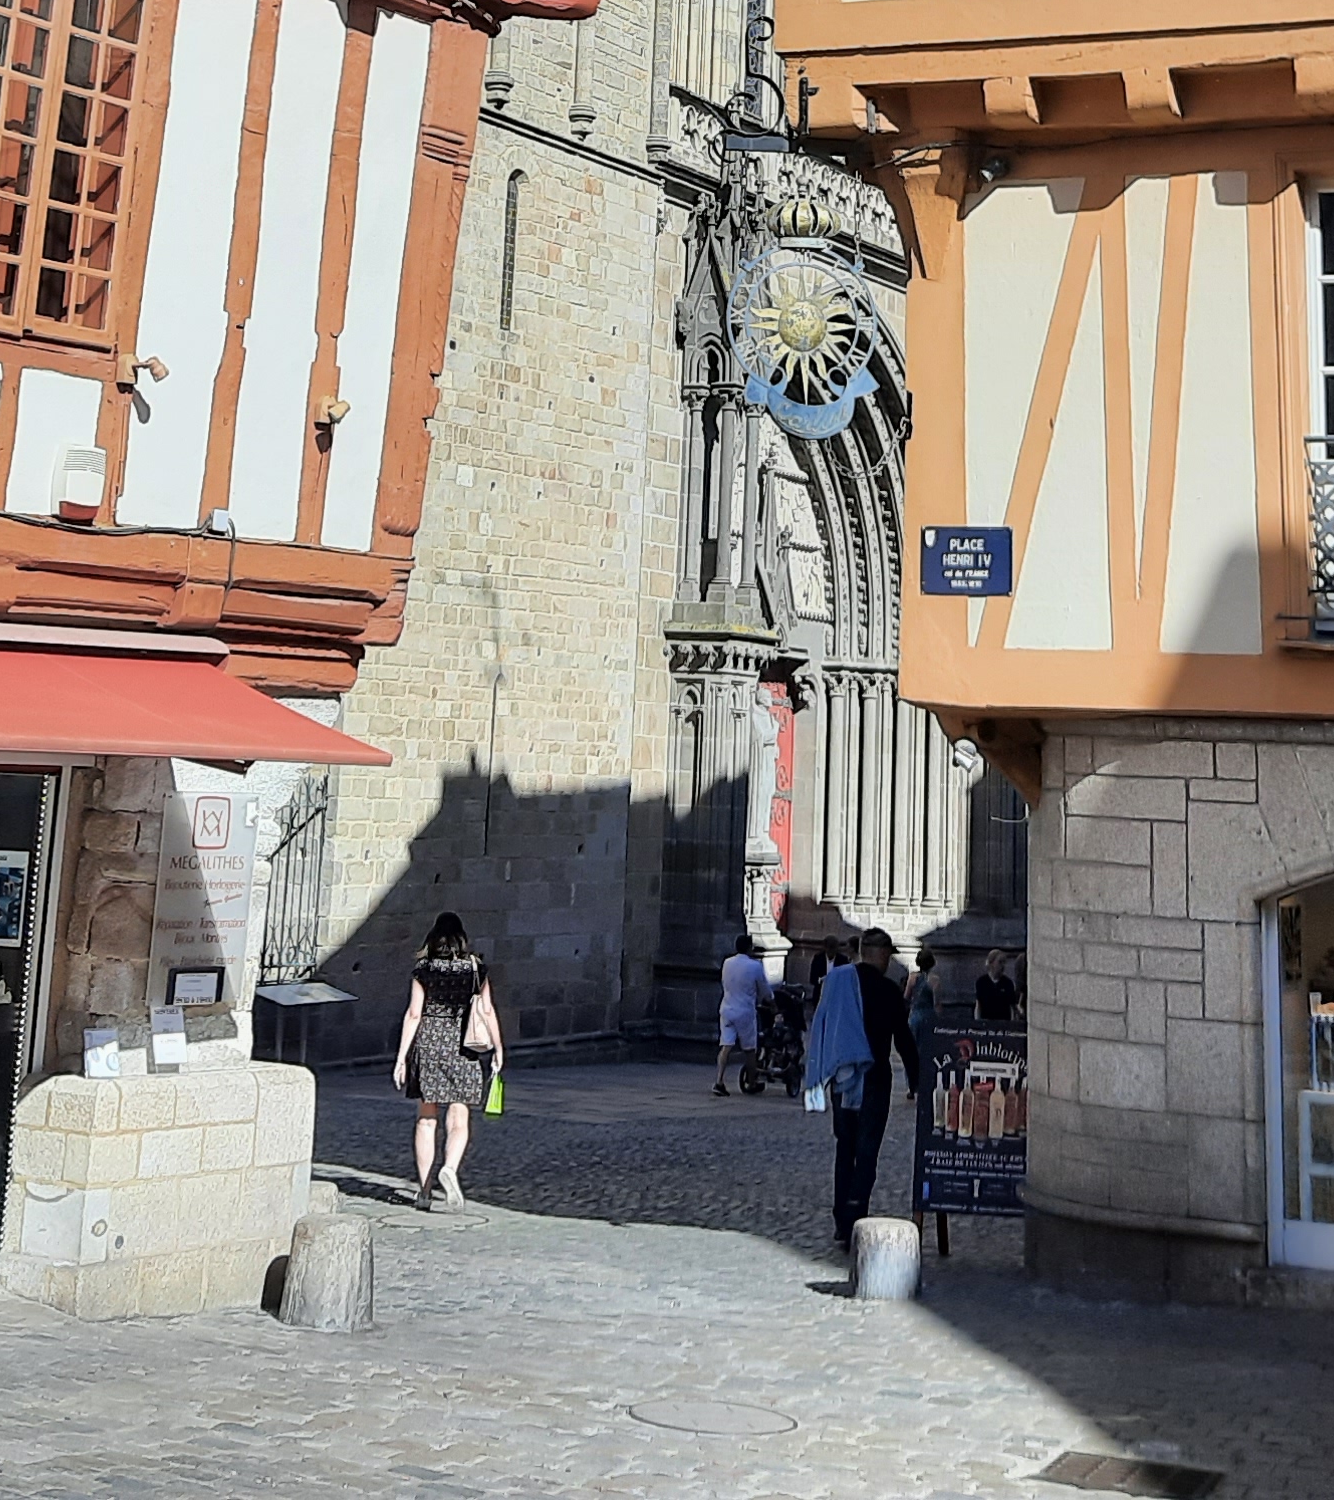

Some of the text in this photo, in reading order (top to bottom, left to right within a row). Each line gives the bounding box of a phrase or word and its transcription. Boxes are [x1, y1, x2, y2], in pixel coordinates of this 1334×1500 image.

[949, 538, 985, 552] PLACE
[942, 553, 992, 568] HENRI IV
[932, 1053, 953, 1070] La
